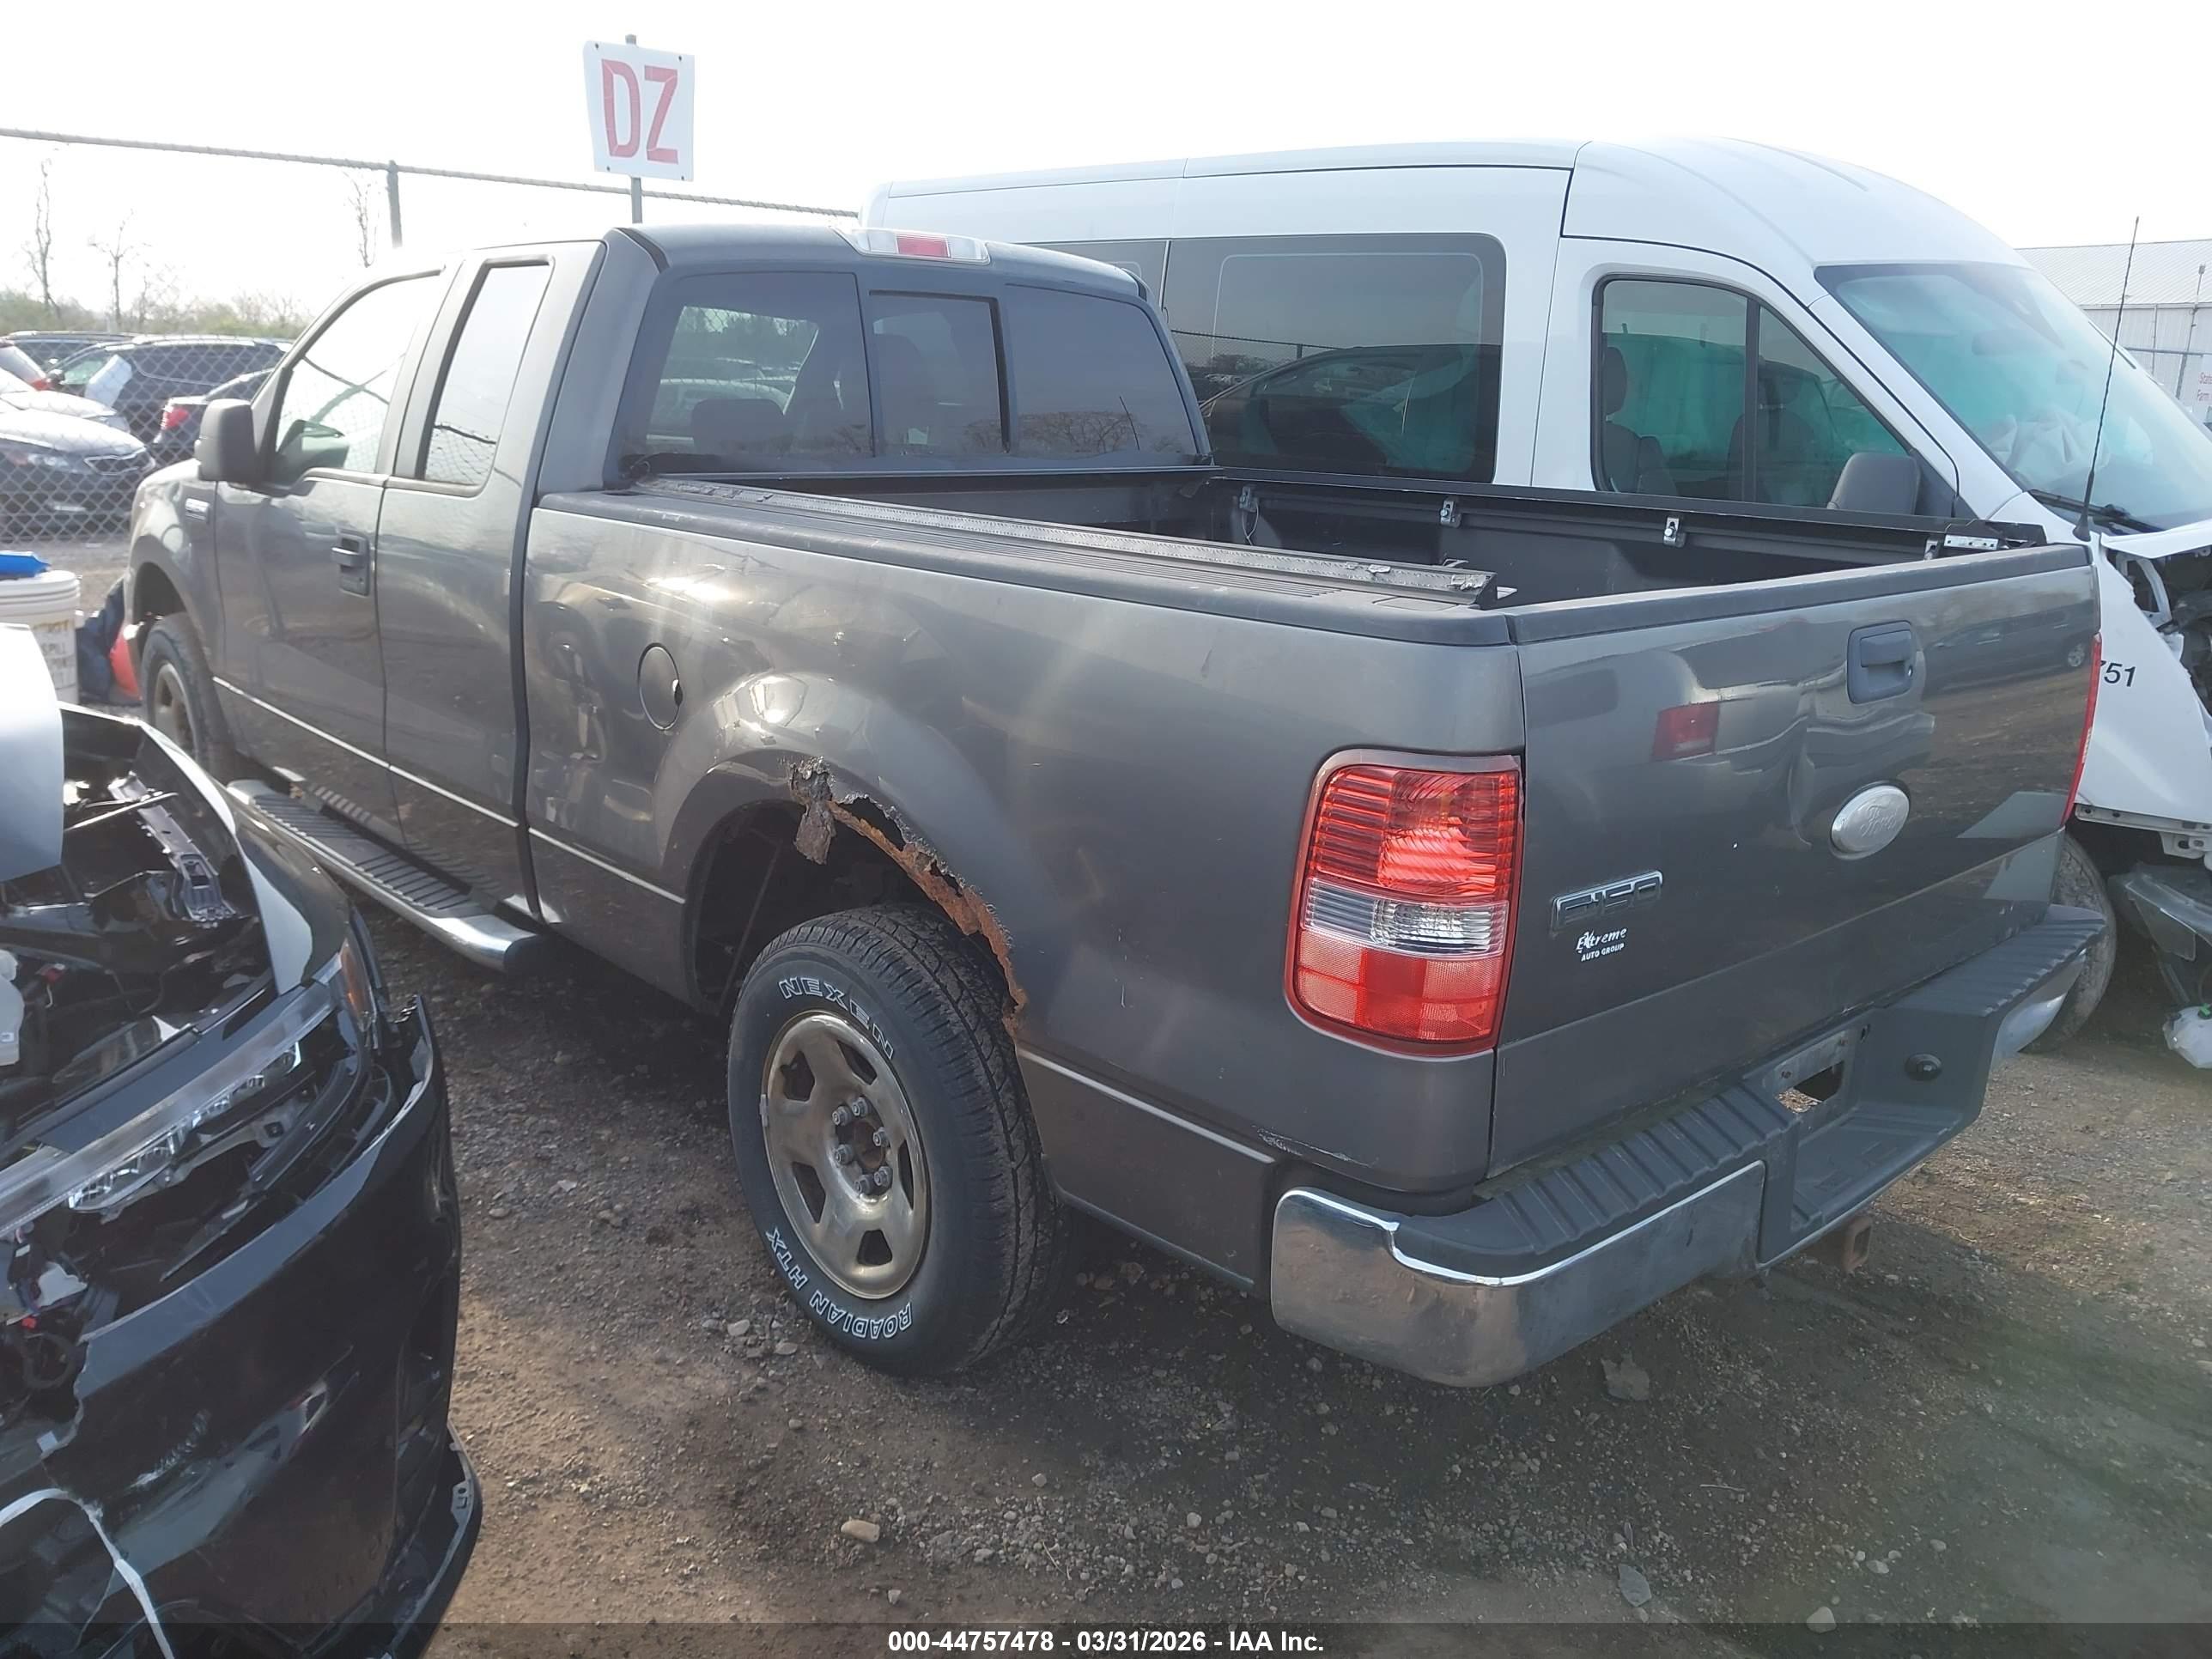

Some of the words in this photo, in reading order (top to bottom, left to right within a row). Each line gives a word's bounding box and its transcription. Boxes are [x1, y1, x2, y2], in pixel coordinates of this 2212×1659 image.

[601, 58, 679, 165] DZ
[1860, 804, 1898, 838] Ford
[1581, 950, 1601, 962] AUTO
[1601, 943, 1625, 956] GROUP
[778, 975, 895, 1060] NEXEN
[765, 1227, 809, 1291] HTX
[809, 1290, 913, 1340] ROADIAN
